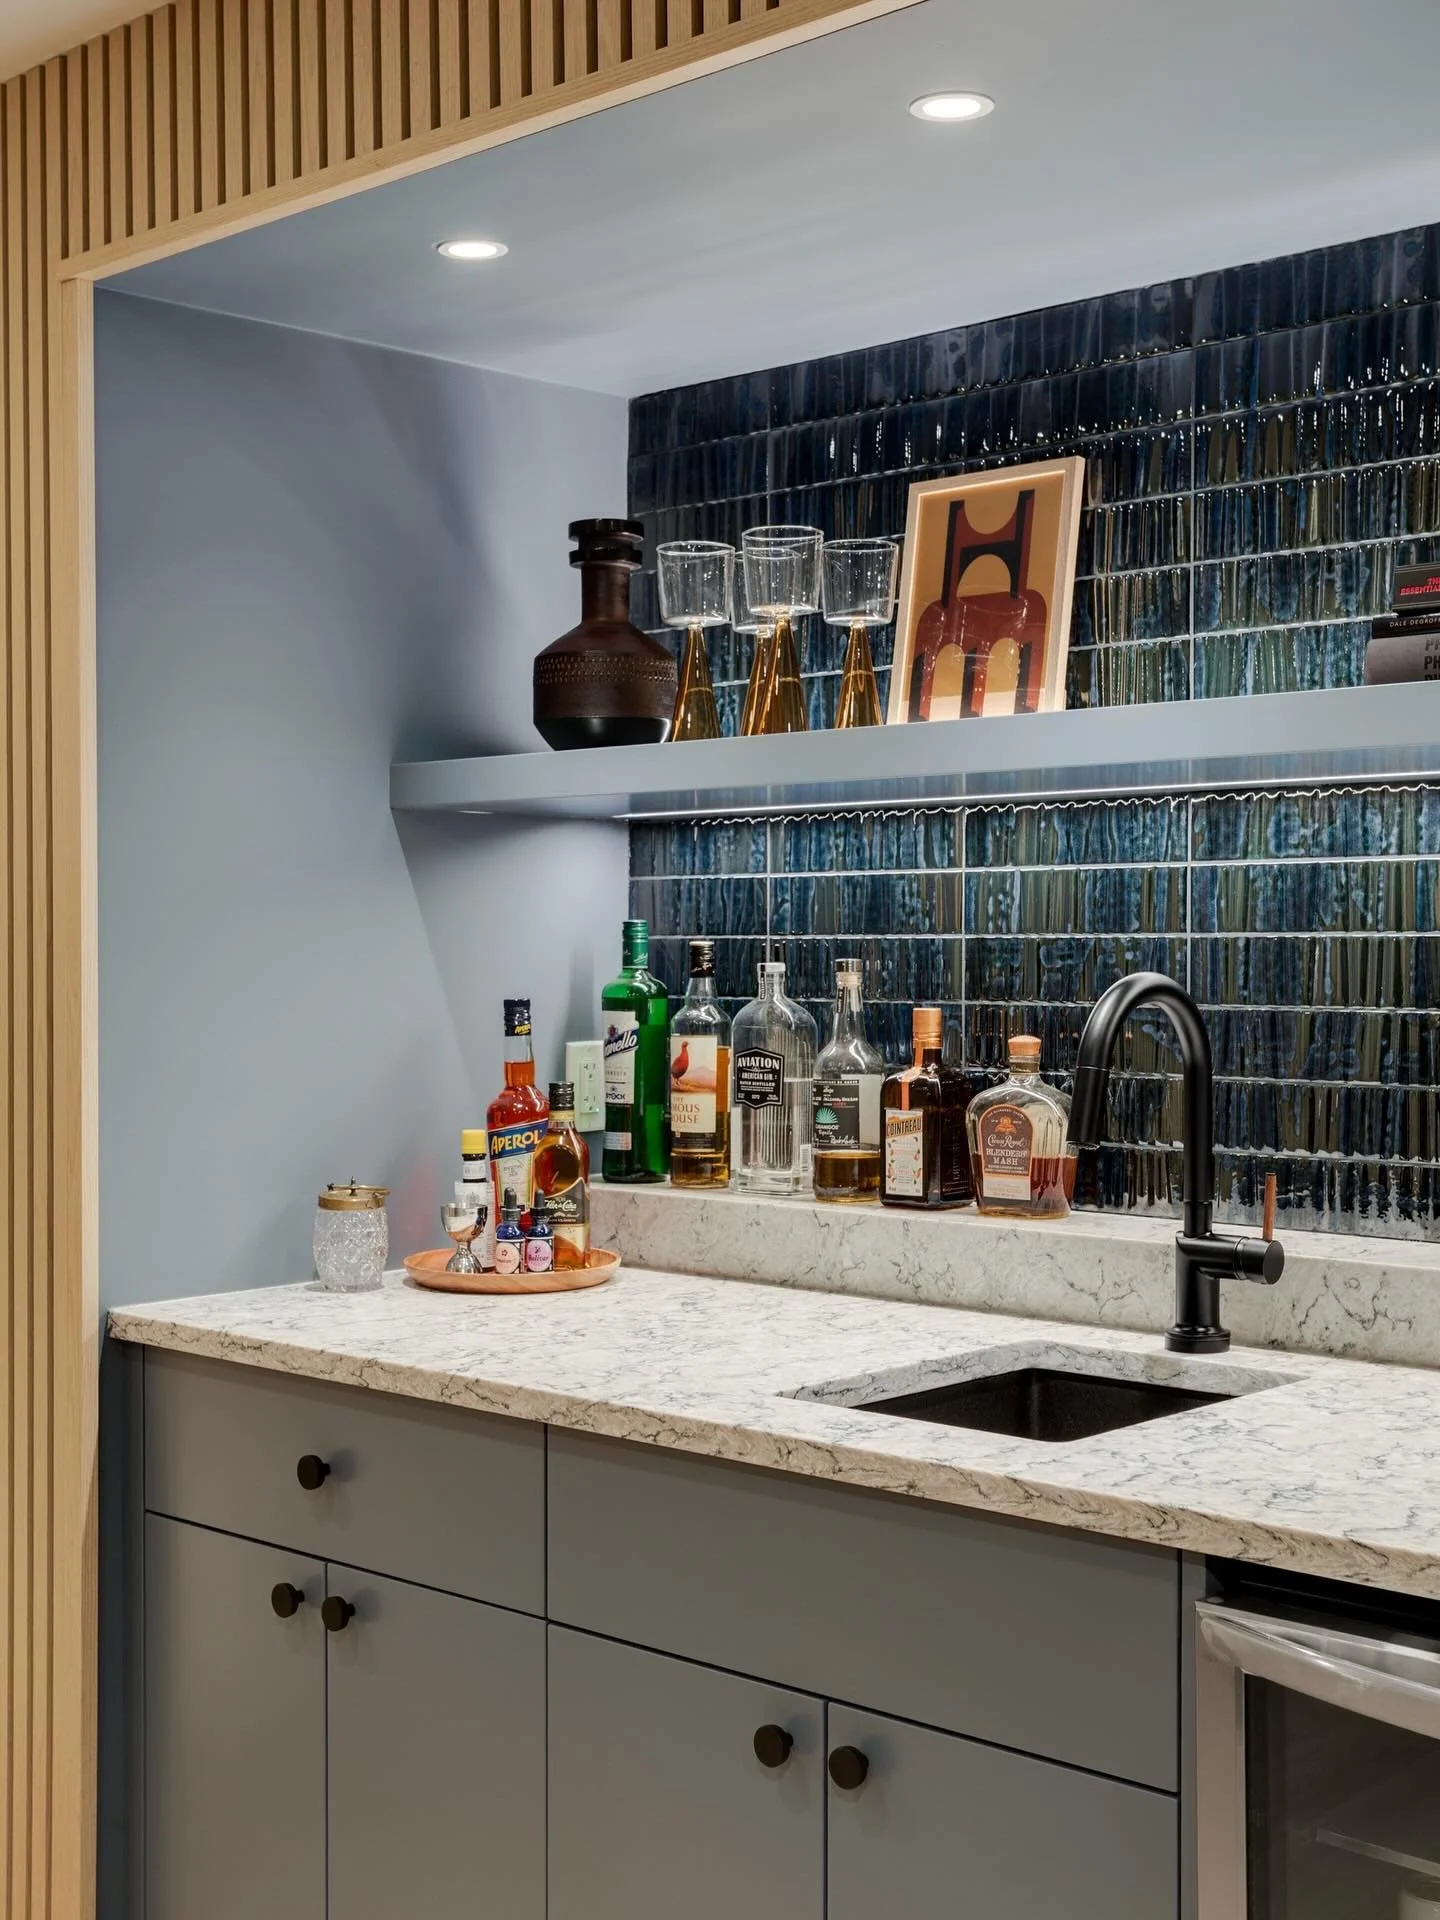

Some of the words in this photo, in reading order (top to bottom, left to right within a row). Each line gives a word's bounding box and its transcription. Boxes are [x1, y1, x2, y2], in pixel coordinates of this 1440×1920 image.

[737, 1056, 780, 1070] AVIATION
[741, 1072, 763, 1080] AMERICAN
[887, 1117, 921, 1137] COINTREAU
[491, 1129, 540, 1155] APEROL
[993, 1157, 1018, 1165] MASH
